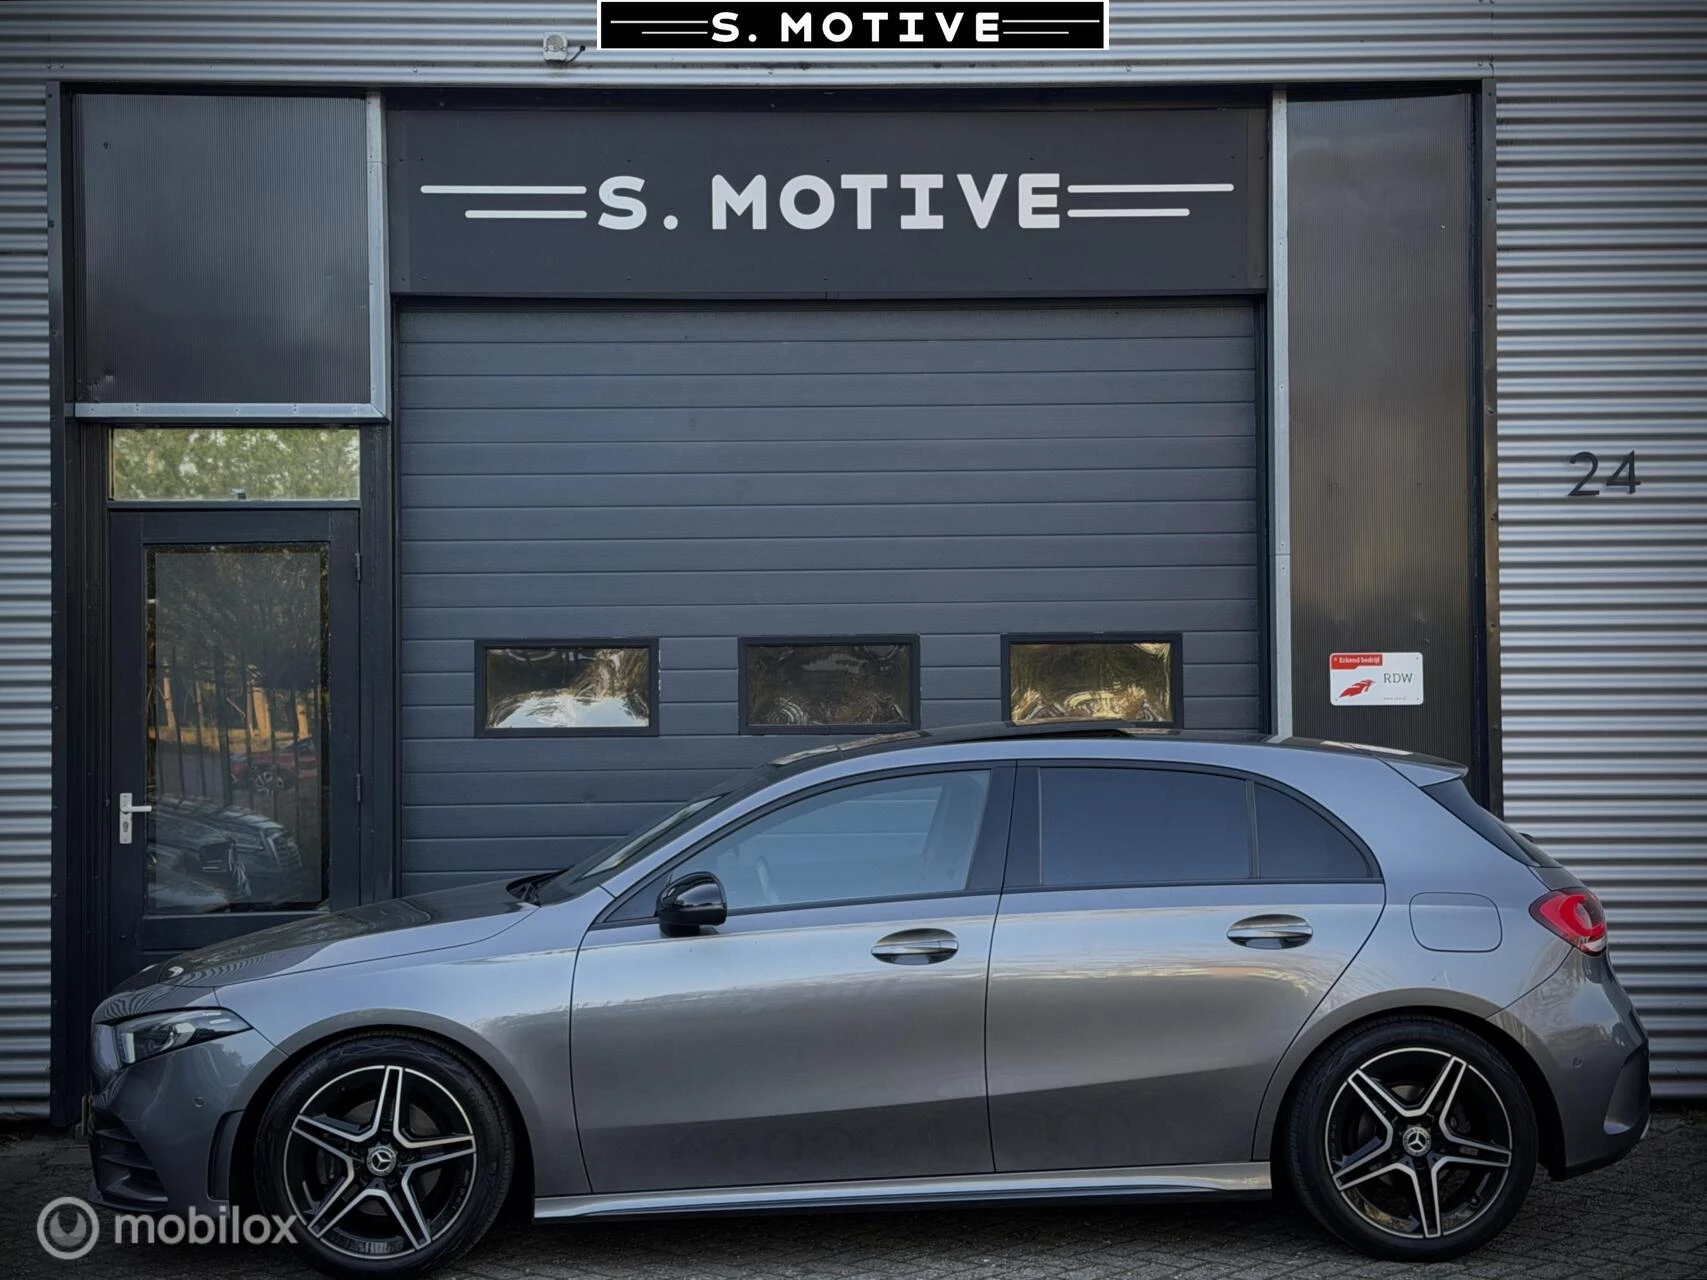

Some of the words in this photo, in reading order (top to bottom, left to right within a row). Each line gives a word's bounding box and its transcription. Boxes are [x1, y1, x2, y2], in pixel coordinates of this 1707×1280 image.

[598, 175, 679, 231] S.
[712, 173, 1060, 230] MOTIVE
[1567, 450, 1641, 496] 24
[1383, 673, 1413, 684] RDW
